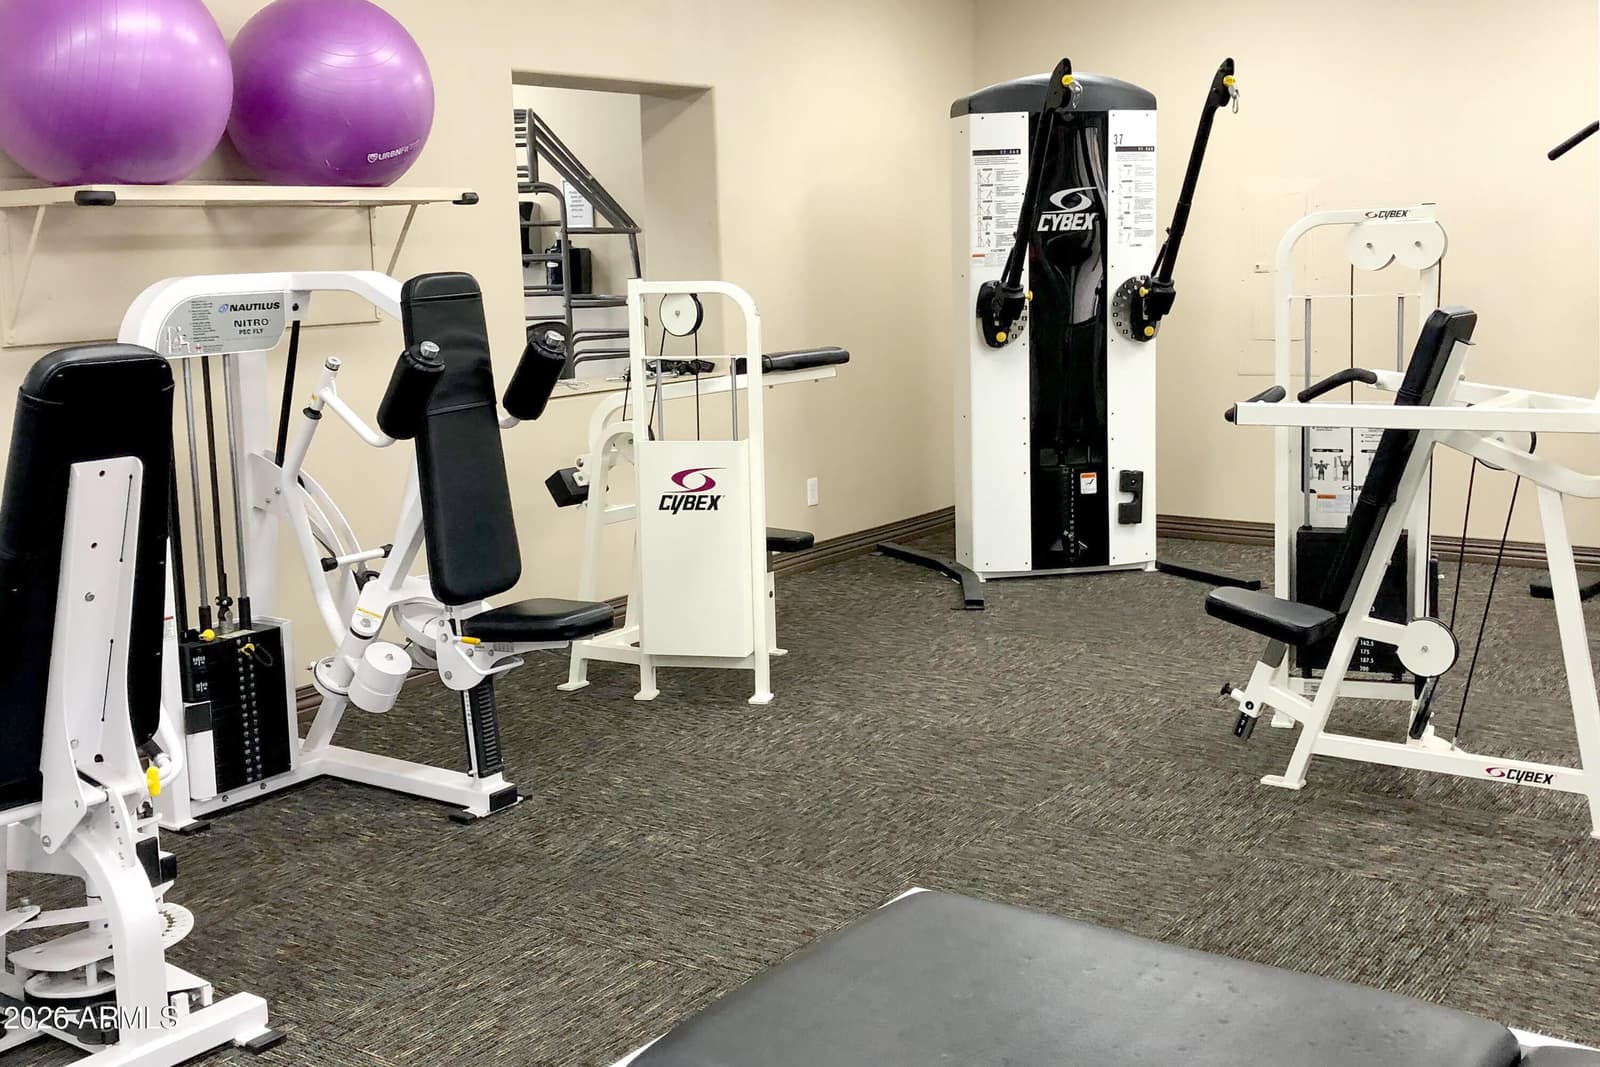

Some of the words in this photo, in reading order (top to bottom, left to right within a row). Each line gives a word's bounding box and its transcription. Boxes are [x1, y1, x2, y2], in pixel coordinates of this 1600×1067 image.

[1113, 134, 1124, 145] 37
[1378, 209, 1409, 220] CYBEX
[1037, 212, 1097, 231] CYBEX
[229, 301, 281, 312] NAUTILUS
[233, 318, 270, 328] NITRO
[658, 494, 722, 515] CYBEX
[1506, 768, 1554, 785] CYBEX
